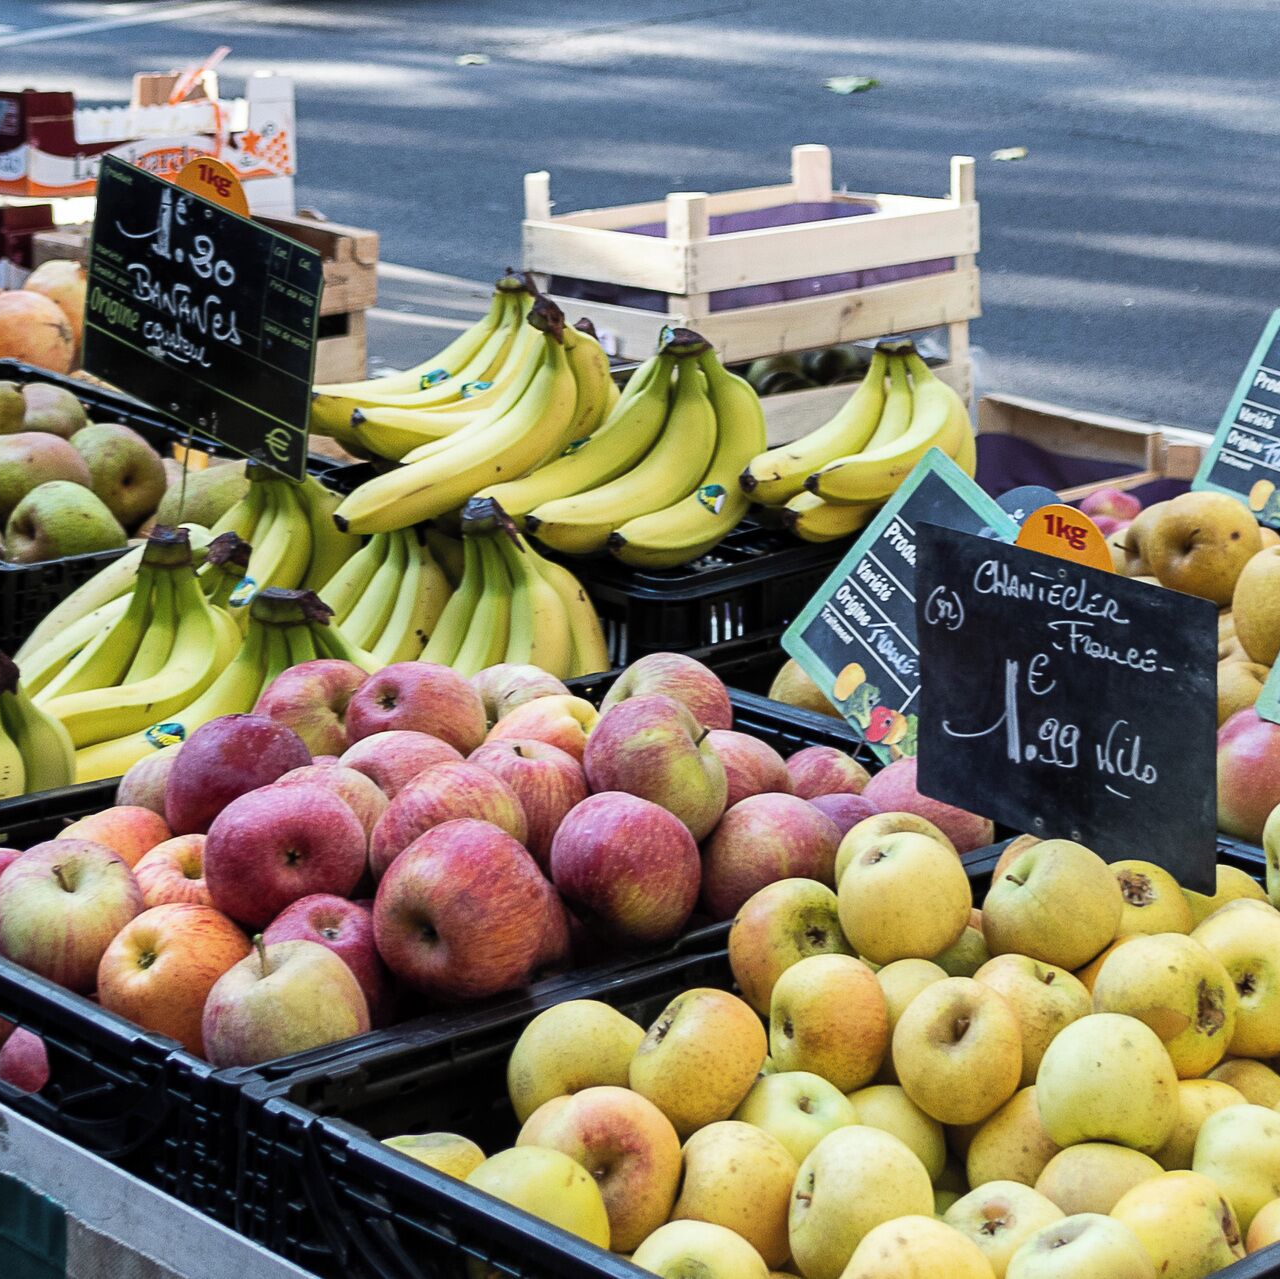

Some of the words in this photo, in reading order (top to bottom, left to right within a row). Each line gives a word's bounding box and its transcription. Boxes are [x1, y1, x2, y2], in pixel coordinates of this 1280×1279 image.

[199, 164, 232, 197] 1kg
[90, 286, 140, 332] Origine
[1238, 407, 1276, 431] Variété
[264, 427, 294, 463] €
[1226, 429, 1263, 455] Origine
[1043, 513, 1088, 551] 1kg
[856, 558, 897, 602] Variété
[835, 584, 872, 627] Origine
